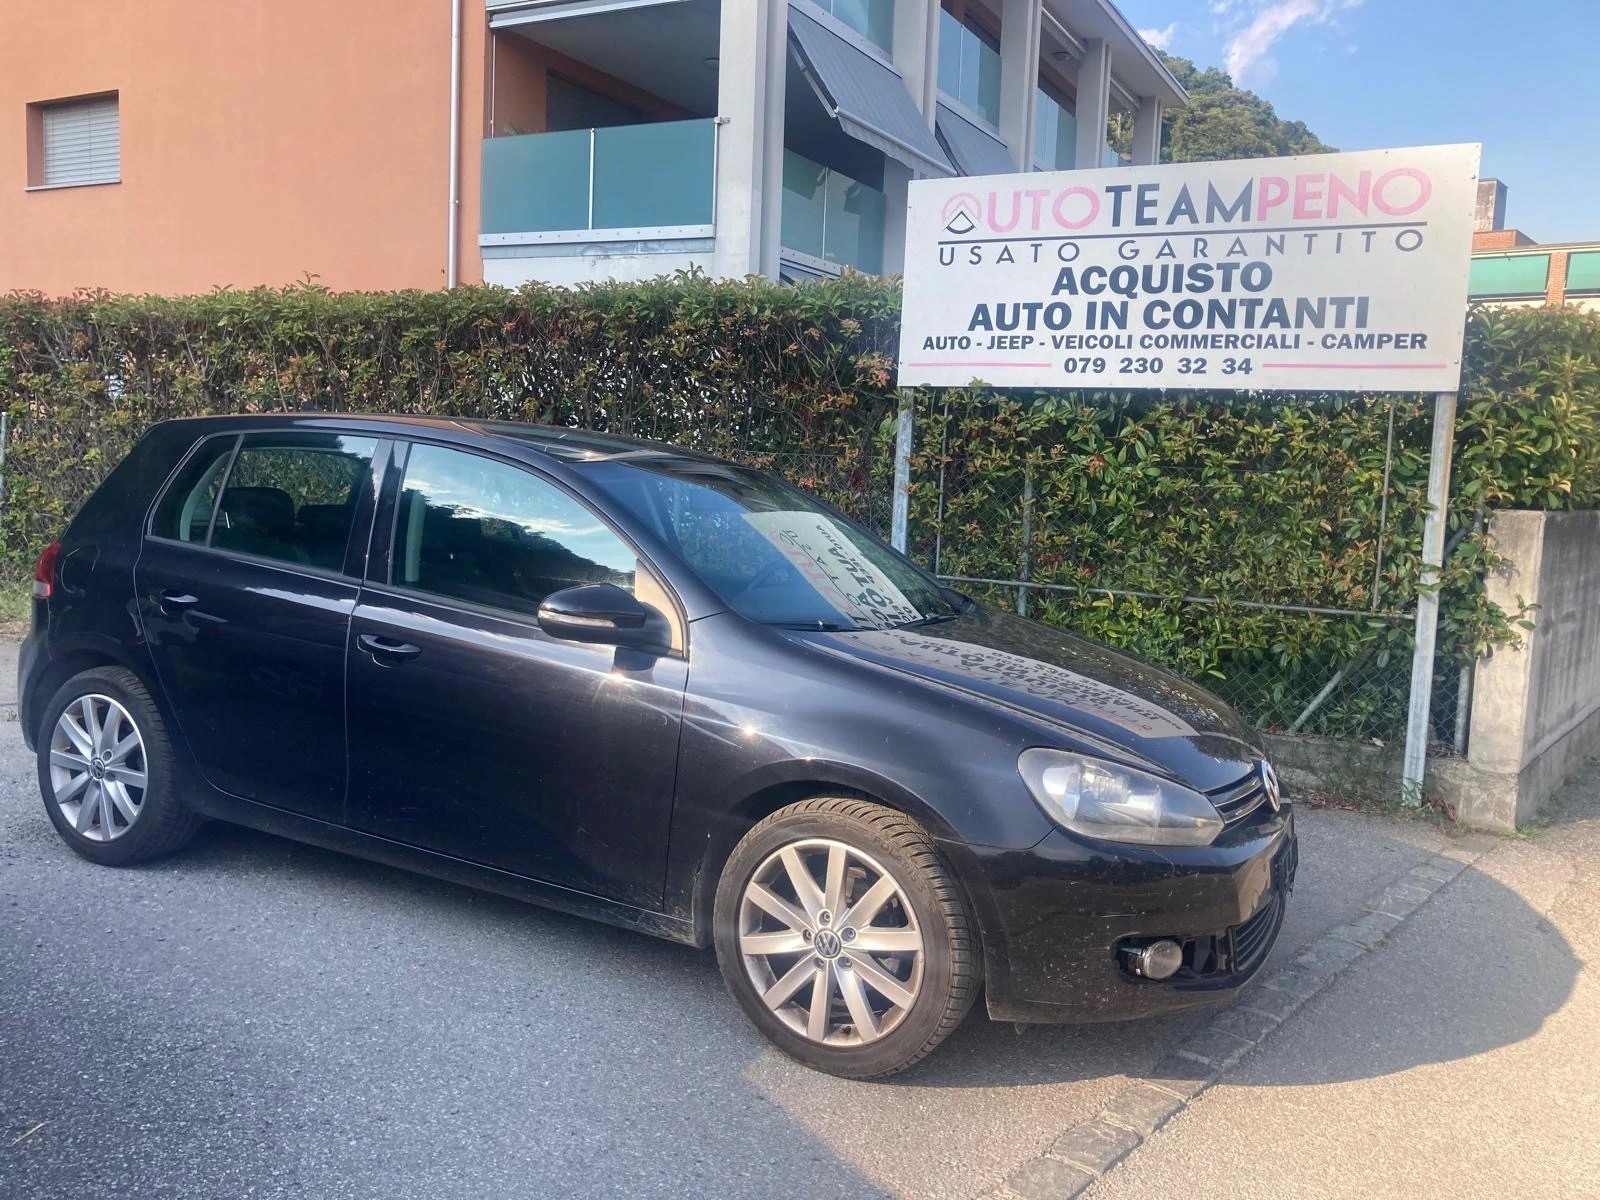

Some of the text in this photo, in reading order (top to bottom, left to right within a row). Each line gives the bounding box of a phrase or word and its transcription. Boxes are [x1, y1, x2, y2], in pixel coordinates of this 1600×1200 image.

[939, 229, 1424, 267] USATO GARANTITO
[1051, 261, 1273, 300] ACQUISTO
[967, 296, 1370, 332] AUTO IN CONTANTI
[922, 335, 972, 351] AUTO
[986, 335, 1035, 350] JEEP
[1051, 334, 1133, 350] VEICOLI
[1139, 333, 1301, 350] COMMERCIALI
[1321, 333, 1428, 350] CAMPER
[1063, 357, 1253, 375] 079 230 32 34
